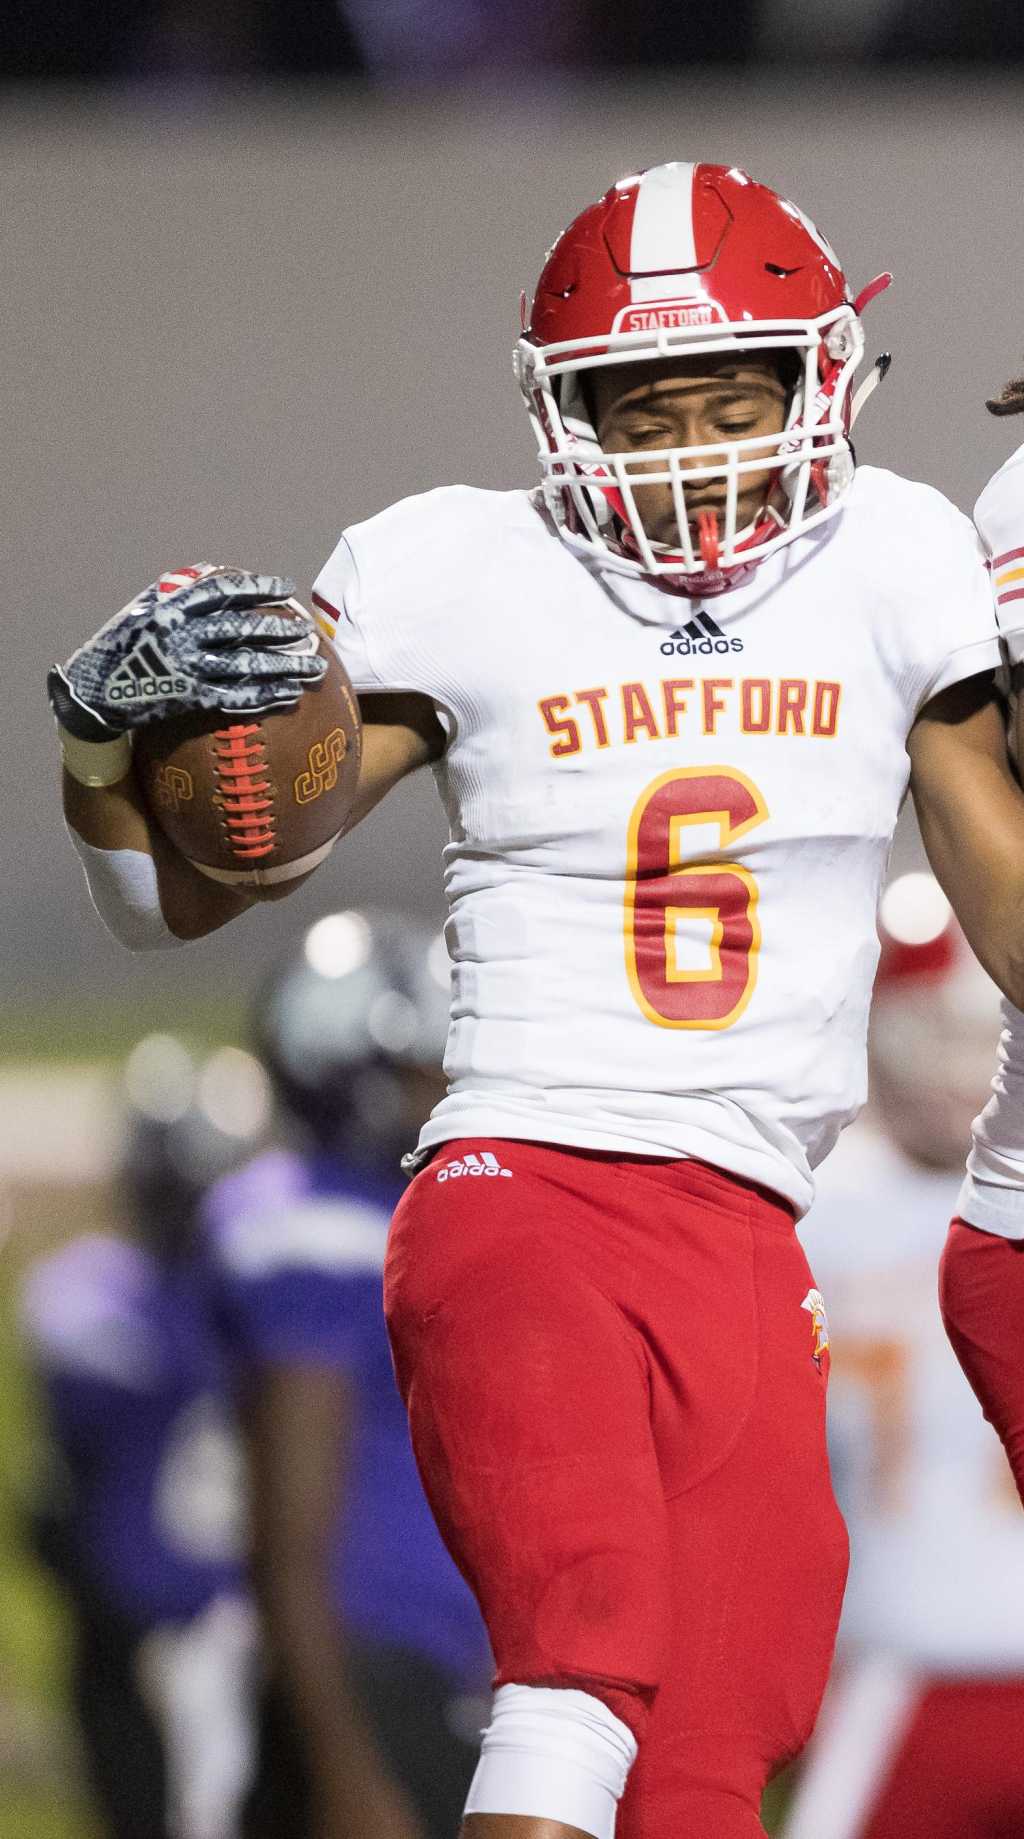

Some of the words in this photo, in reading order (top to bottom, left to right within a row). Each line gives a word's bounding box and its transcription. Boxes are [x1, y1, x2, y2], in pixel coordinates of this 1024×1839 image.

[629, 306, 712, 331] STAFFORD
[659, 636, 744, 656] adidas
[109, 678, 187, 700] adidas
[537, 677, 842, 759] STAFFORD
[623, 764, 771, 1030] 6
[436, 1163, 513, 1182] adidas
